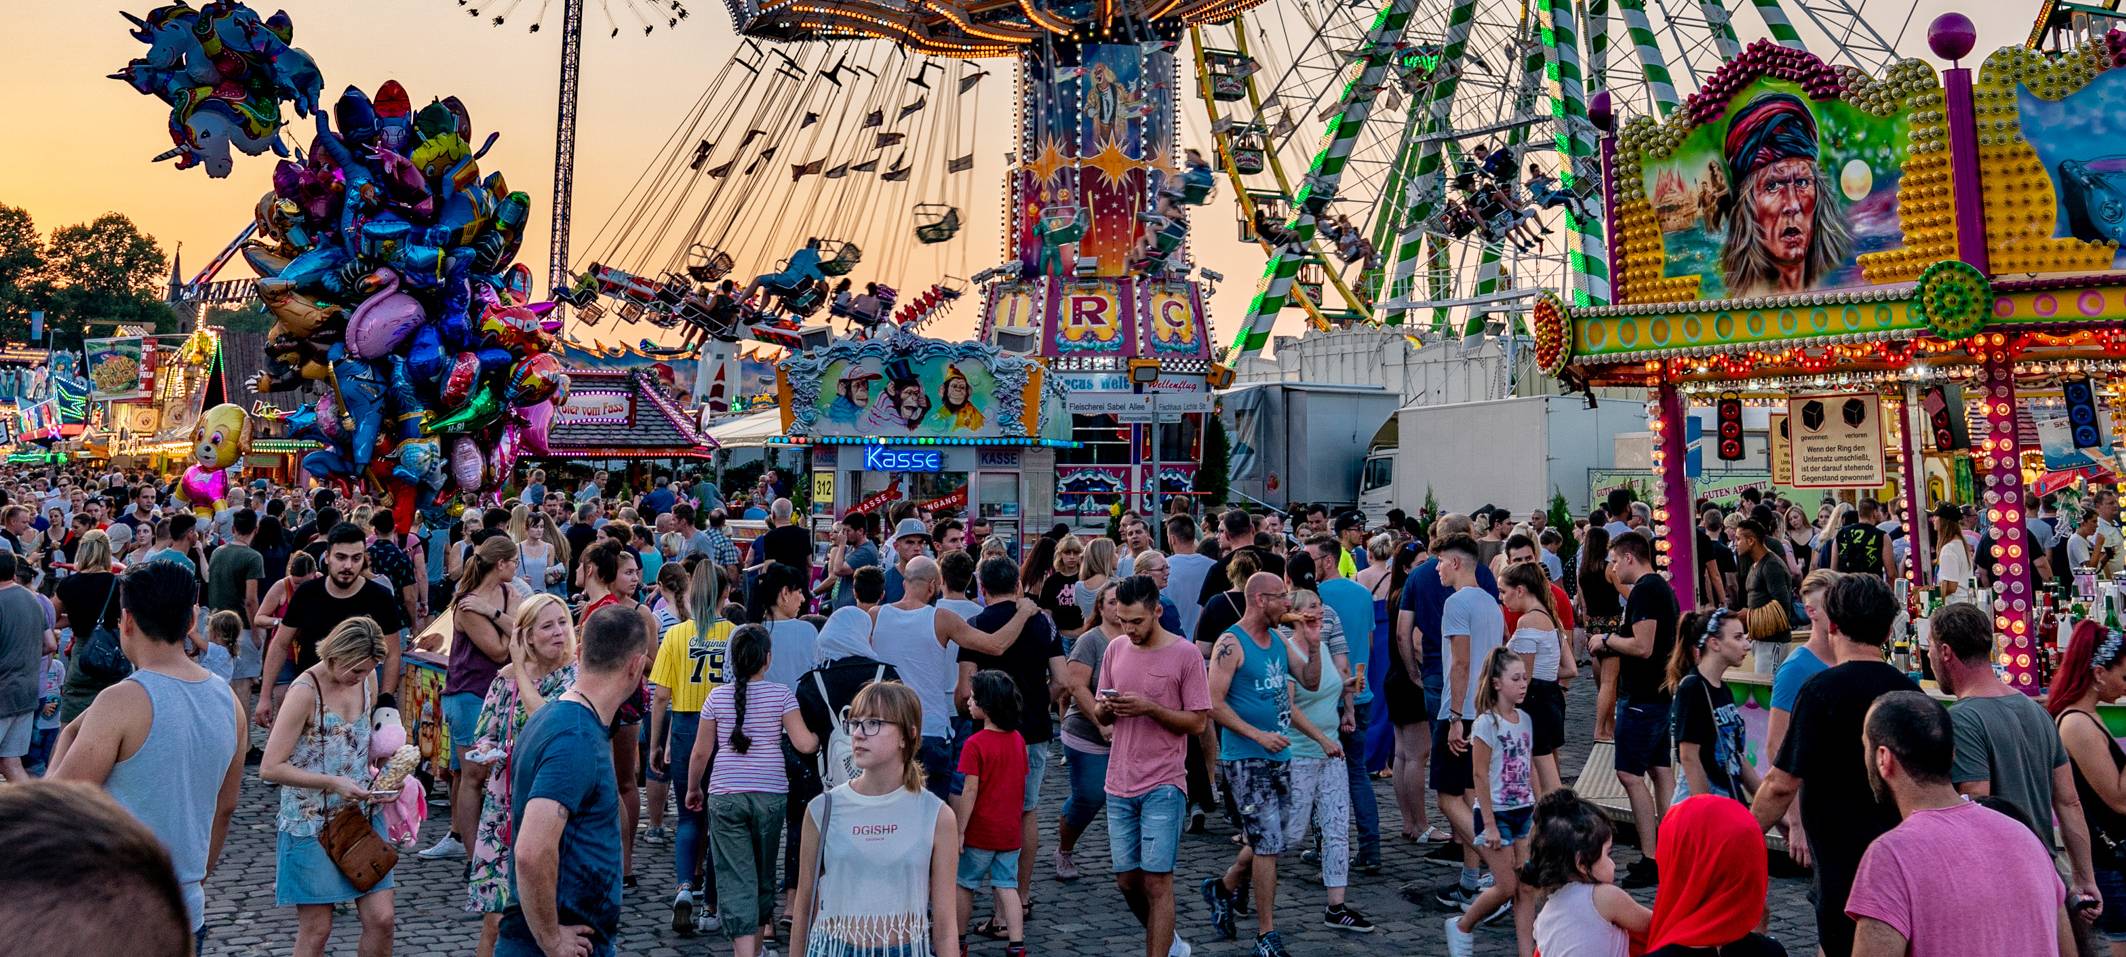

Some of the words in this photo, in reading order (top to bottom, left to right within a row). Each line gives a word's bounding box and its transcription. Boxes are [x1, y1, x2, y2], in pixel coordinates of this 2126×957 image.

[1070, 296, 1109, 326] R
[1162, 300, 1185, 328] C
[1101, 375, 1130, 390] Welt
[582, 406, 601, 416] vom
[603, 402, 624, 415] Fass
[1801, 434, 1828, 442] gewonnen
[1838, 444, 1852, 453] Ring
[1853, 444, 1865, 452] den
[867, 446, 938, 468] Kasse
[981, 453, 1017, 464] KASSE
[1801, 474, 1839, 483] Gegenstand
[1840, 473, 1874, 482] gewonnen!
[816, 480, 832, 495] 312
[1702, 487, 1730, 499] GUTEN
[857, 493, 888, 513] KASSE
[852, 824, 898, 836] DGISHP
